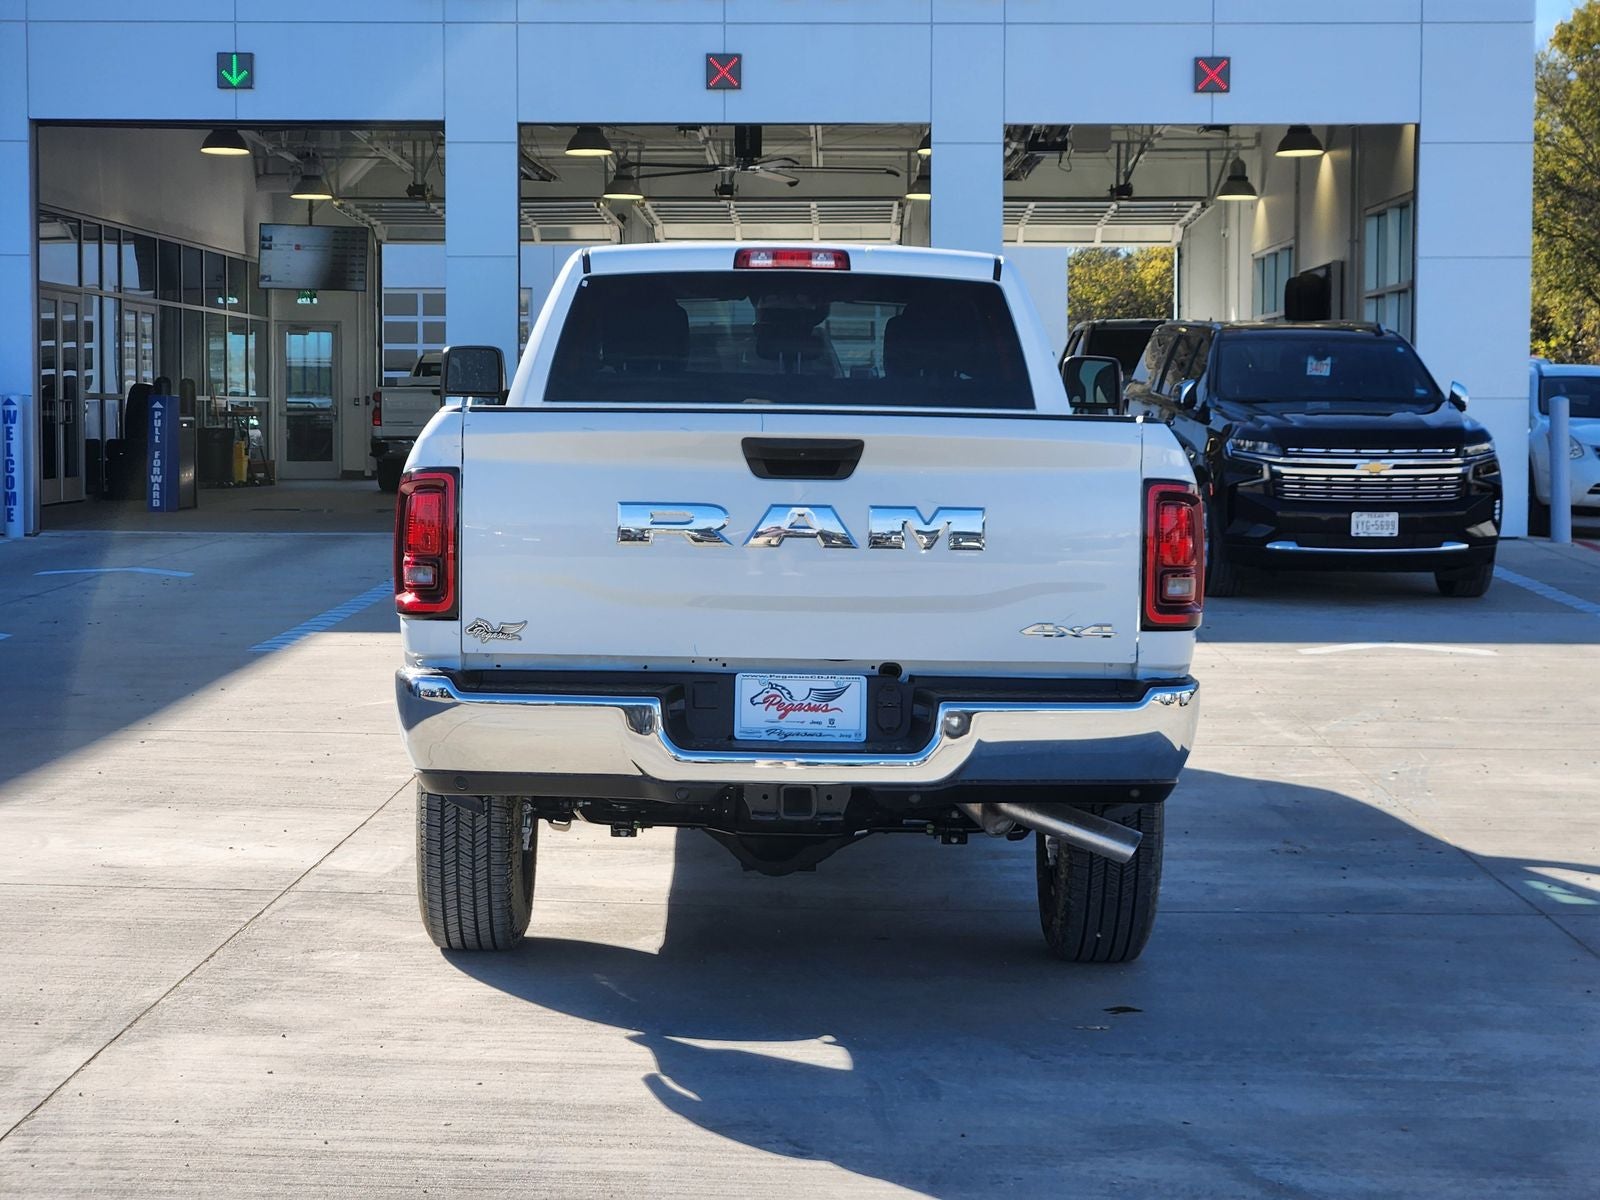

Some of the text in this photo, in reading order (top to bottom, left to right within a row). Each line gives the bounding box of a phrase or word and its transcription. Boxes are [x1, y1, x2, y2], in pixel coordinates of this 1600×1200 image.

[2, 409, 18, 523] WELCOME
[150, 410, 163, 507] PULL FORWARD
[616, 501, 986, 551] RAM
[474, 627, 521, 643] Pegasus
[762, 693, 843, 720] Pegasus
[765, 728, 835, 740] Pegasus
